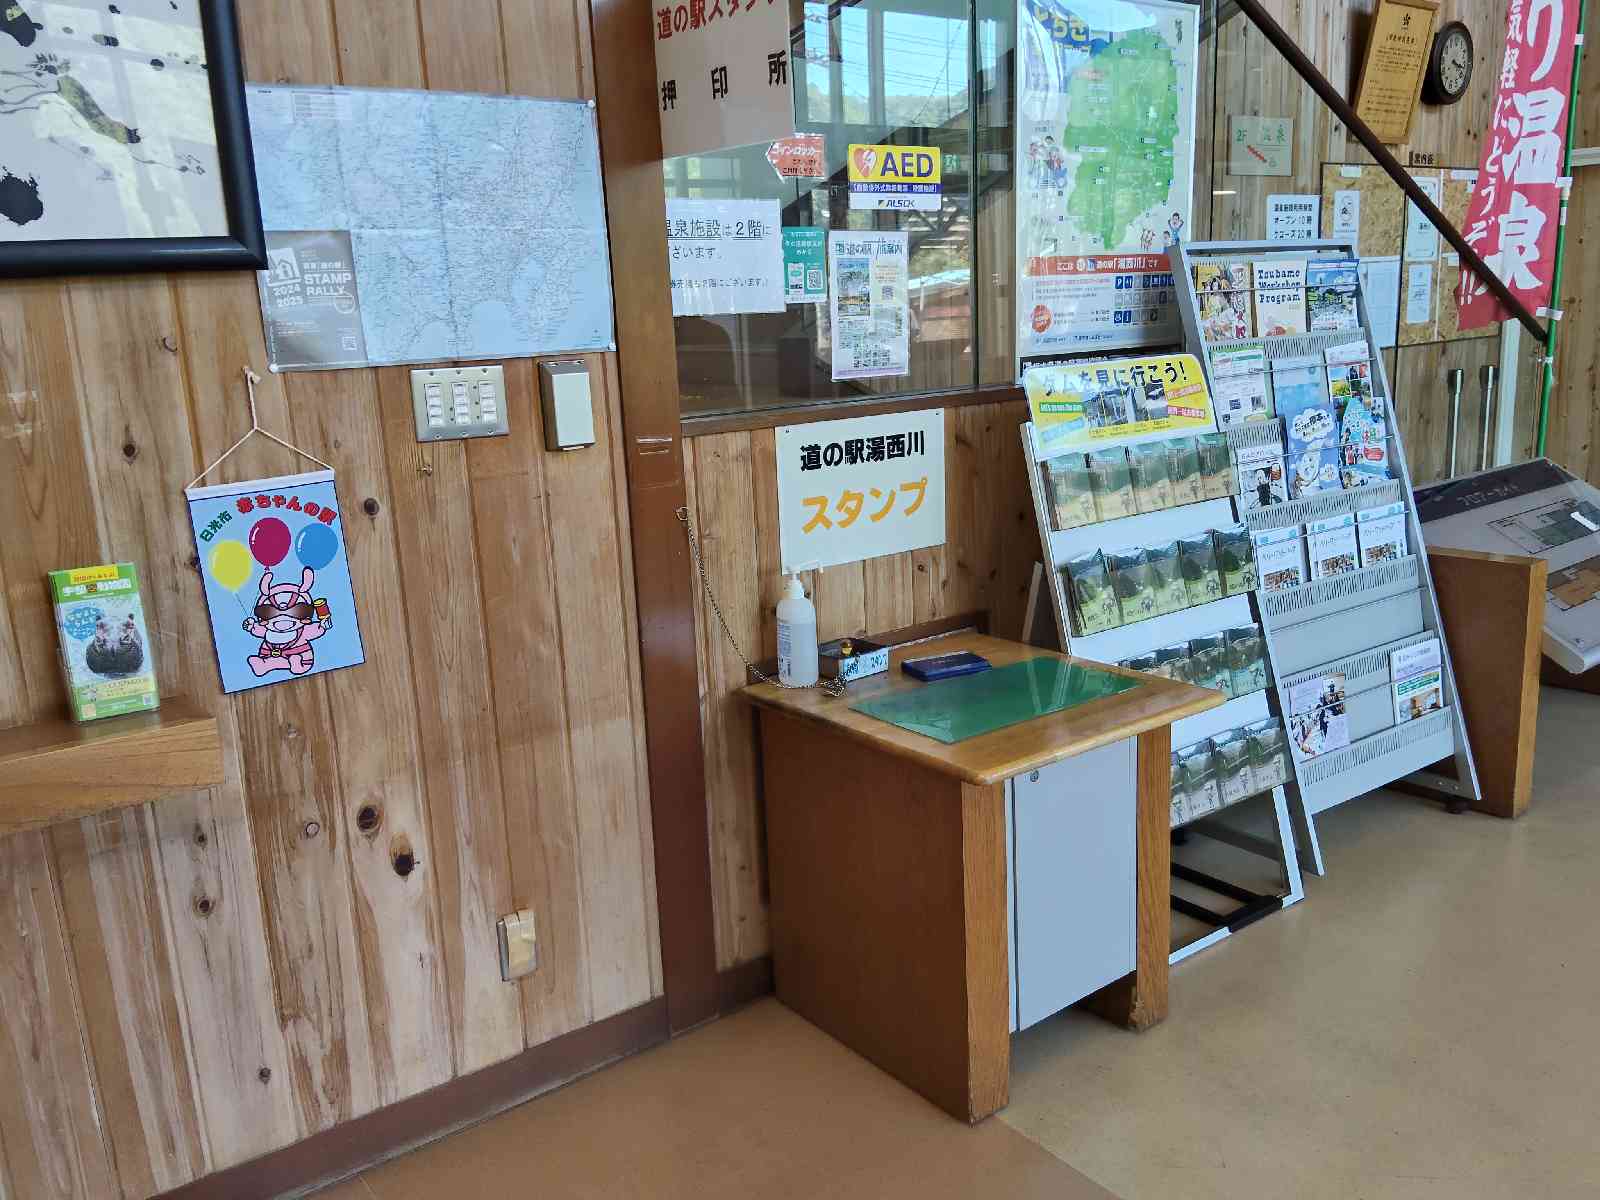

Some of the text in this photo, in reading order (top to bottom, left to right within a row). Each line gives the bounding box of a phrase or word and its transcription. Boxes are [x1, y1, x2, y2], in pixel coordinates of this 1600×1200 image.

[880, 152, 934, 177] AED
[303, 272, 352, 286] STAMP
[306, 285, 346, 297] RALLY
[1259, 293, 1301, 305] Program
[799, 430, 925, 472] 道の駅湯西川
[235, 494, 338, 526] 赤ちゃんの駅
[801, 476, 928, 534] スタンプ
[200, 510, 232, 543] 日光市
